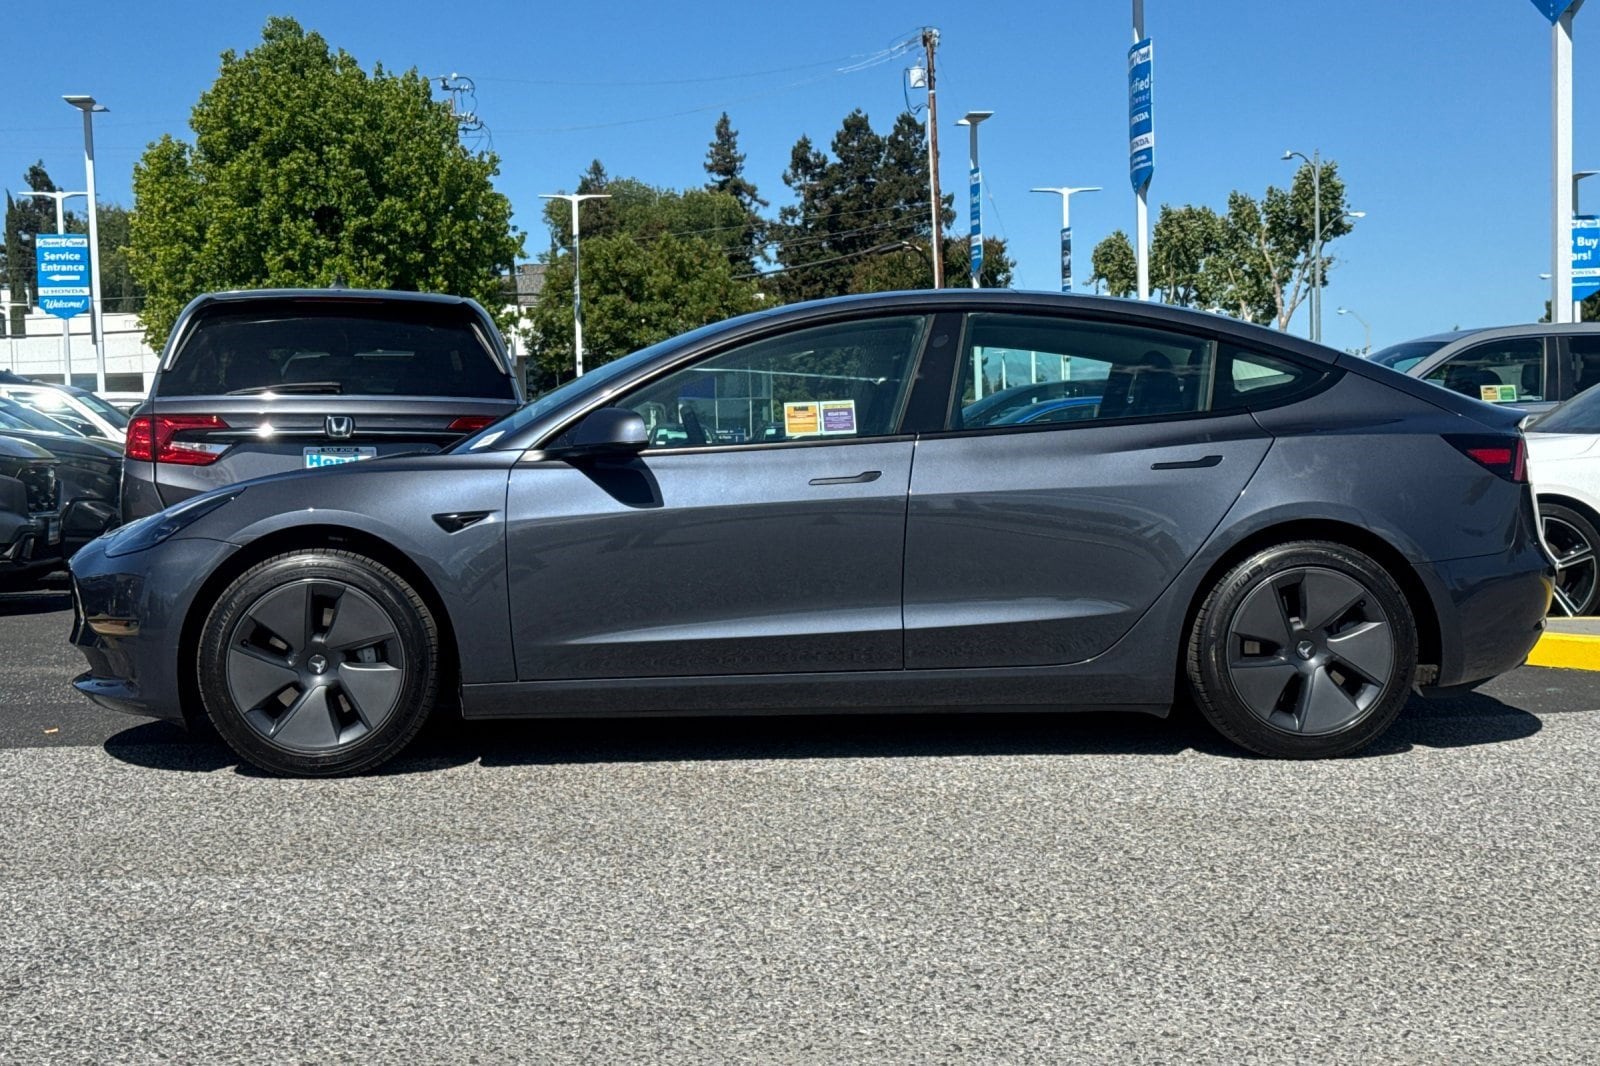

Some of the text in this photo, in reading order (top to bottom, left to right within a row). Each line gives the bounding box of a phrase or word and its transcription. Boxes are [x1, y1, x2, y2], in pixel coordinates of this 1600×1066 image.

[1577, 236, 1599, 249] Buy
[43, 251, 81, 261] Service
[1571, 250, 1592, 261] ars!
[41, 263, 85, 272] Entrance
[43, 299, 85, 310] Welcome!
[308, 454, 359, 468] Hond
